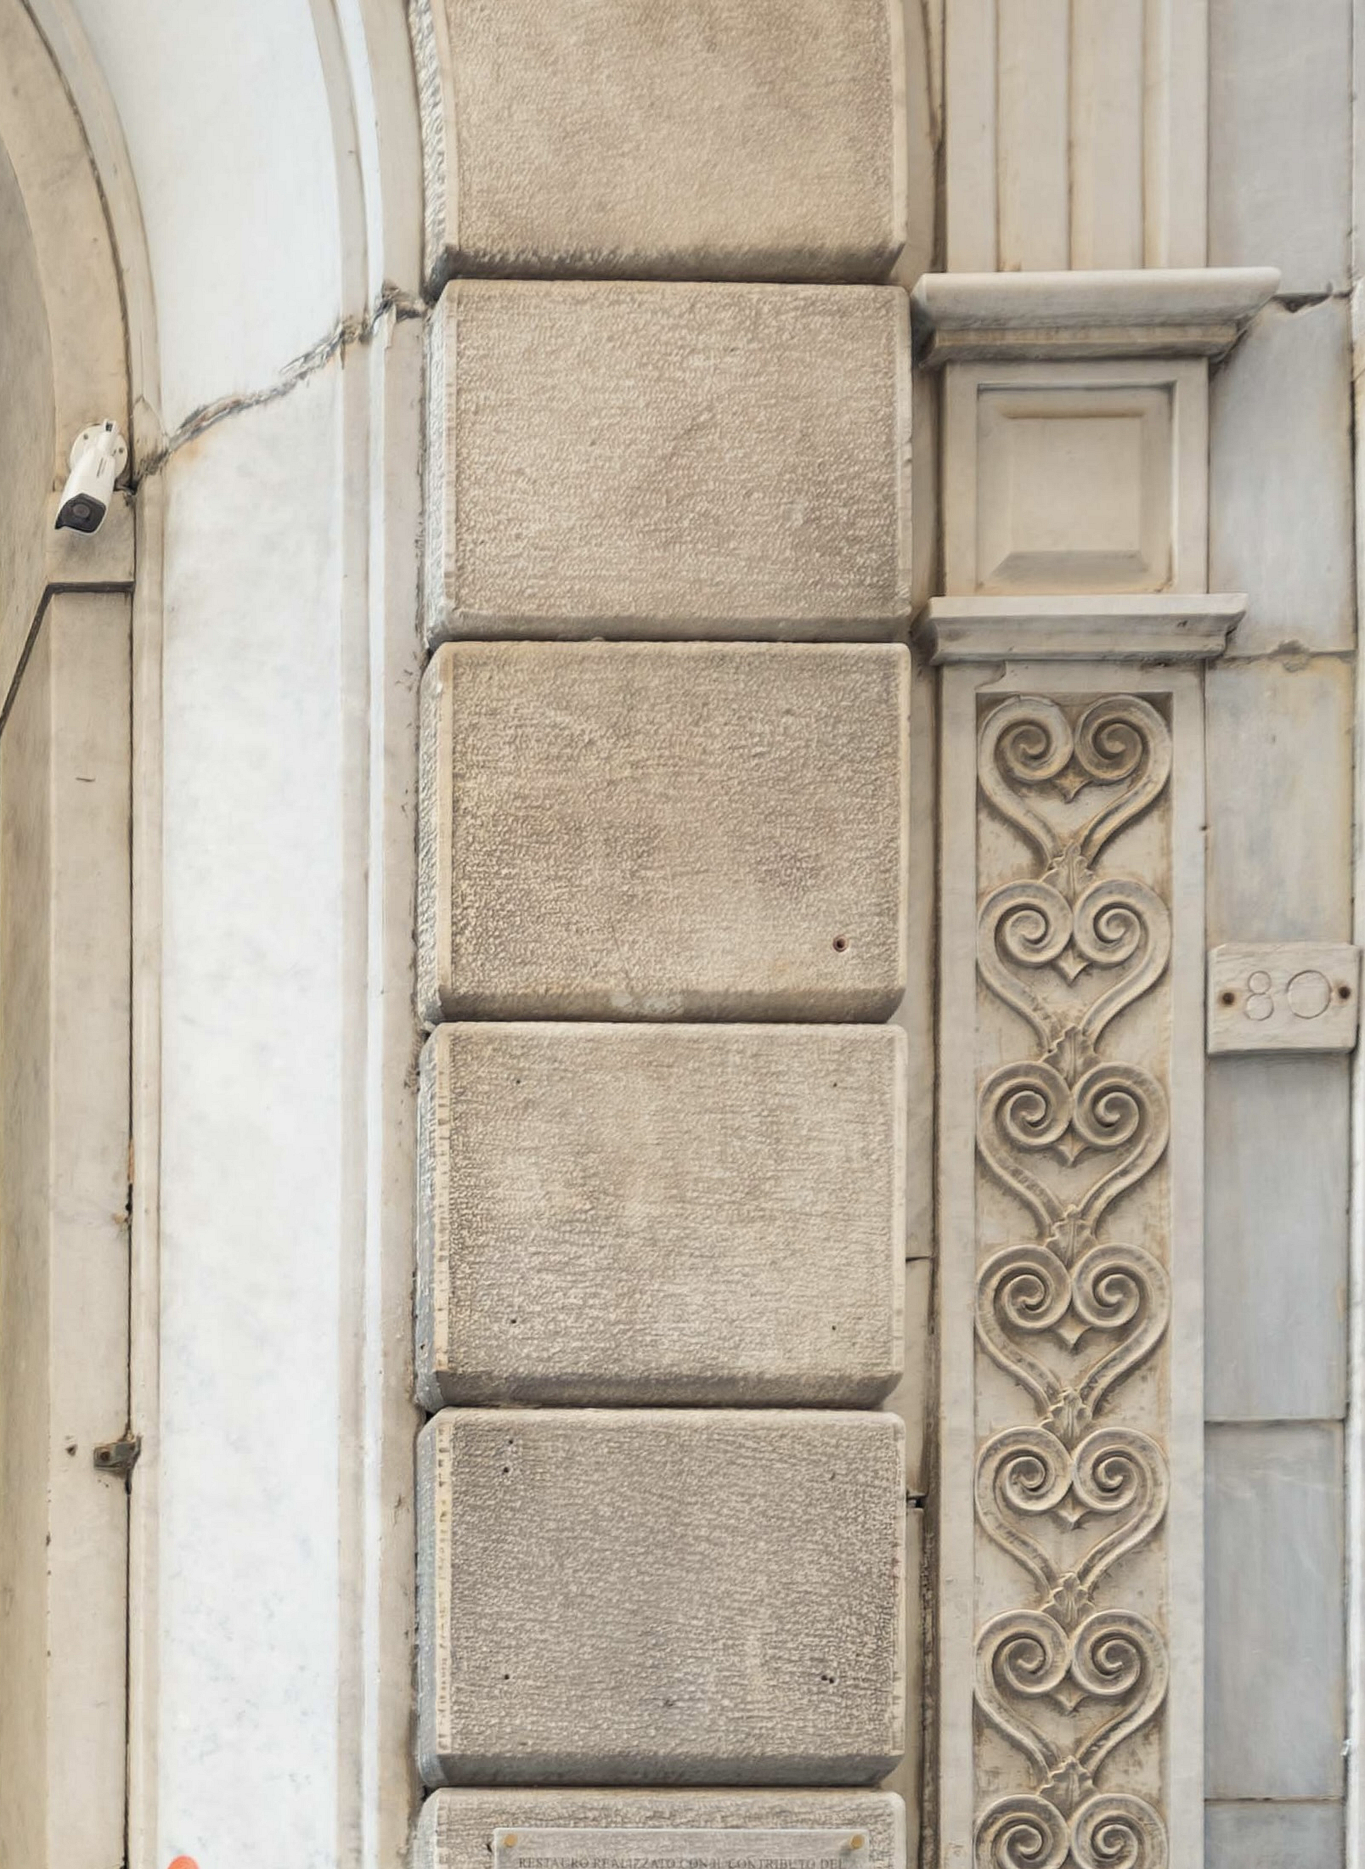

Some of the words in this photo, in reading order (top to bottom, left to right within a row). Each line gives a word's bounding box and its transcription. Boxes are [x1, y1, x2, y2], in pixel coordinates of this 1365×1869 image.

[518, 1856, 590, 1869] RESTAURO
[593, 1857, 676, 1869] REALIZZATO
[727, 1857, 816, 1869] CONTRIBUTO
[819, 1858, 846, 1869] DEL
